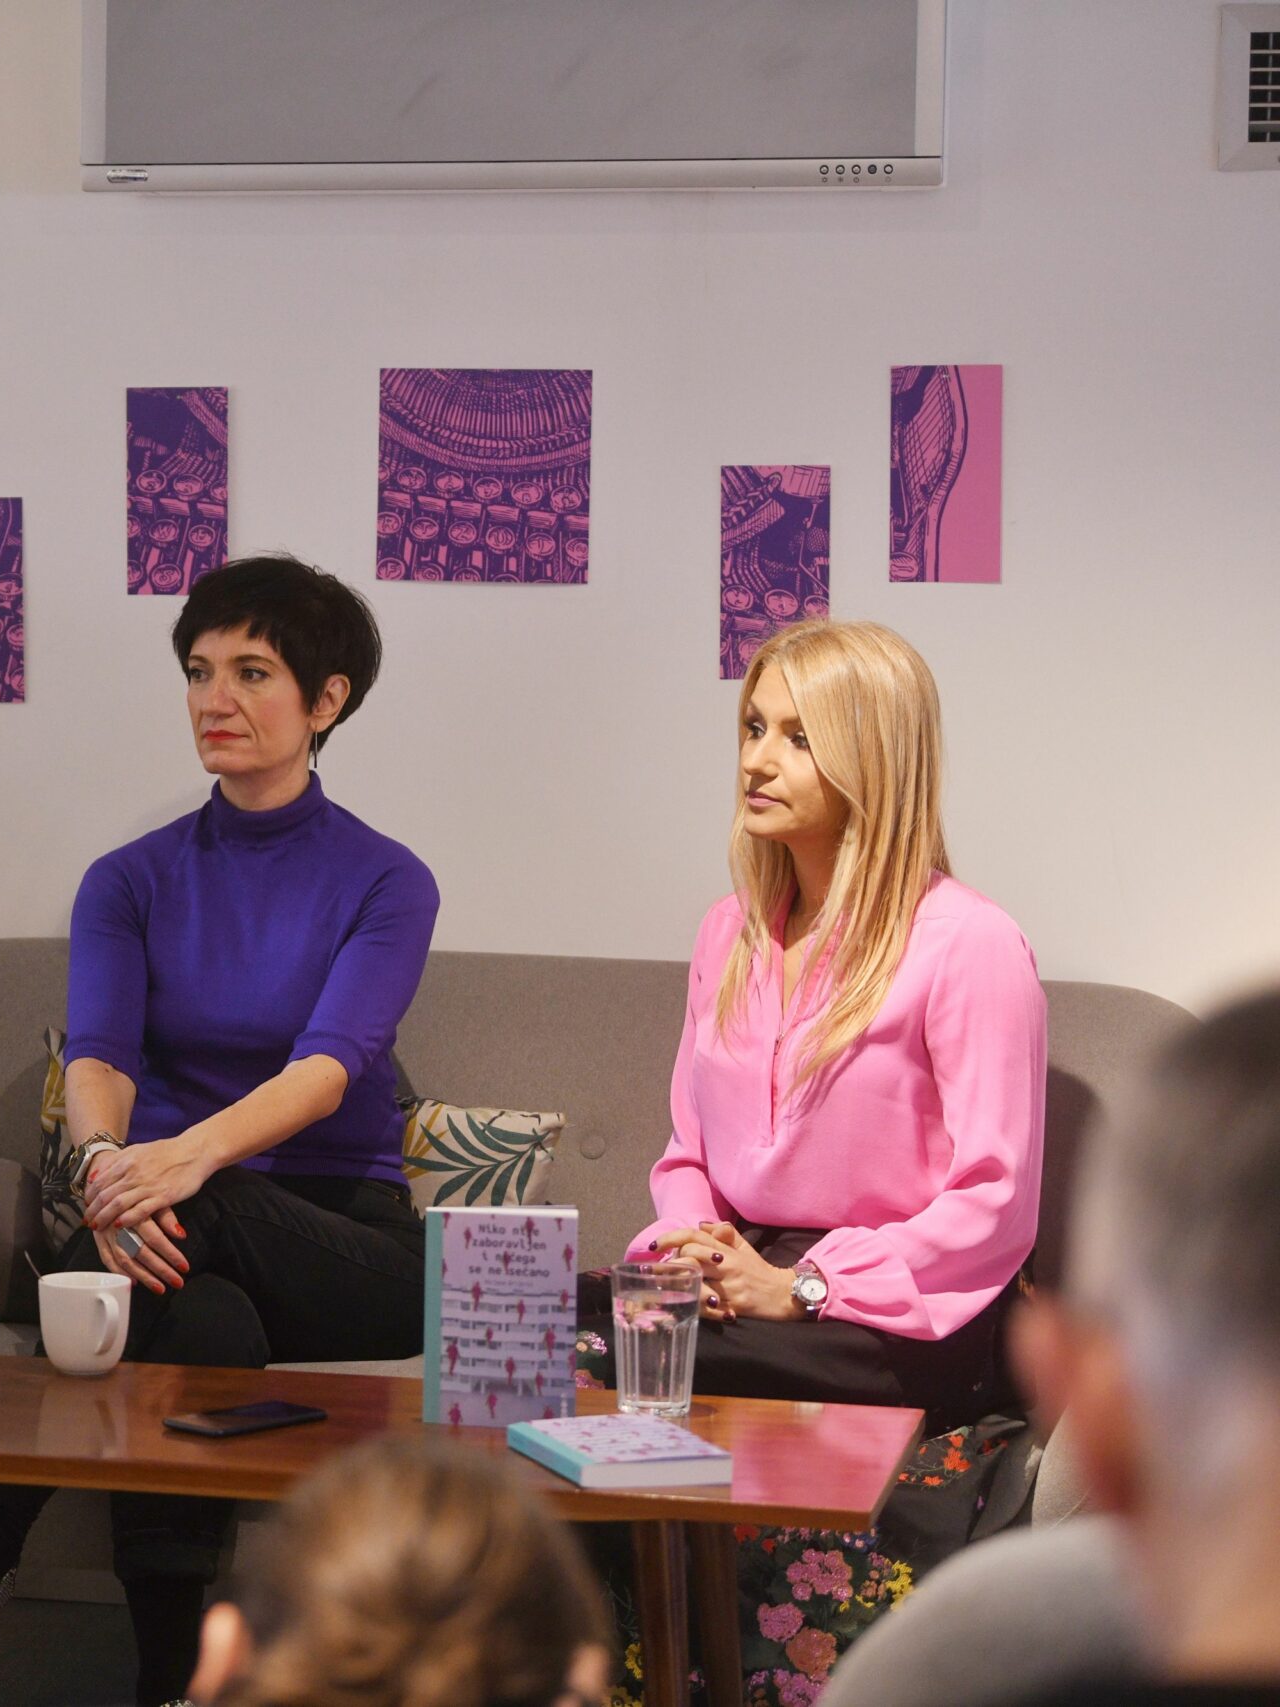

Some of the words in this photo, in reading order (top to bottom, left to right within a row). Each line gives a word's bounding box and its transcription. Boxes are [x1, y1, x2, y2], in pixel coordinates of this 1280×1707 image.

[478, 1224, 506, 1235] Niko
[512, 1225, 540, 1237] nie
[472, 1237, 547, 1251] zaboravljen
[468, 1266, 482, 1275] se
[488, 1266, 503, 1275] ne
